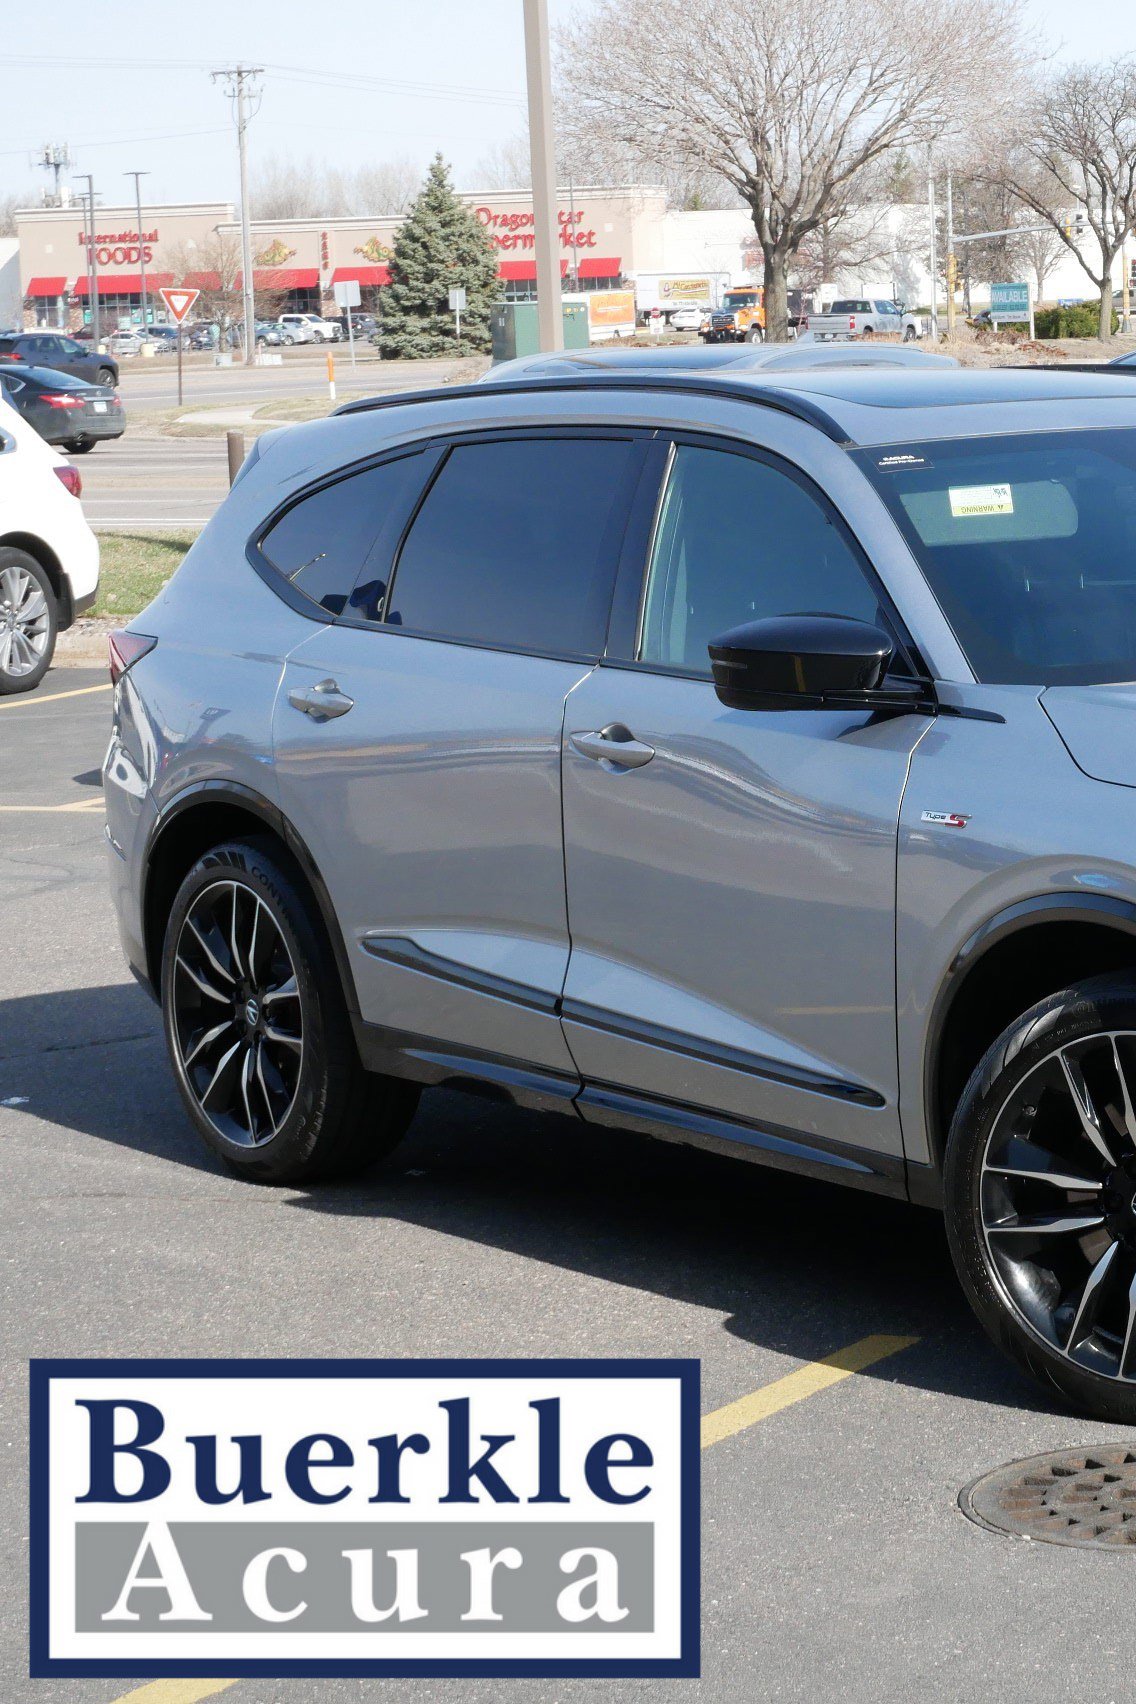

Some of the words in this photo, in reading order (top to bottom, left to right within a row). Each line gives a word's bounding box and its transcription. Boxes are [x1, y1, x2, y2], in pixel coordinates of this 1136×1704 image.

[557, 209, 584, 225] tar
[78, 229, 159, 246] Inernational
[489, 223, 598, 250] permket
[992, 290, 1028, 303] AVAILABLE
[961, 505, 994, 514] WARNING
